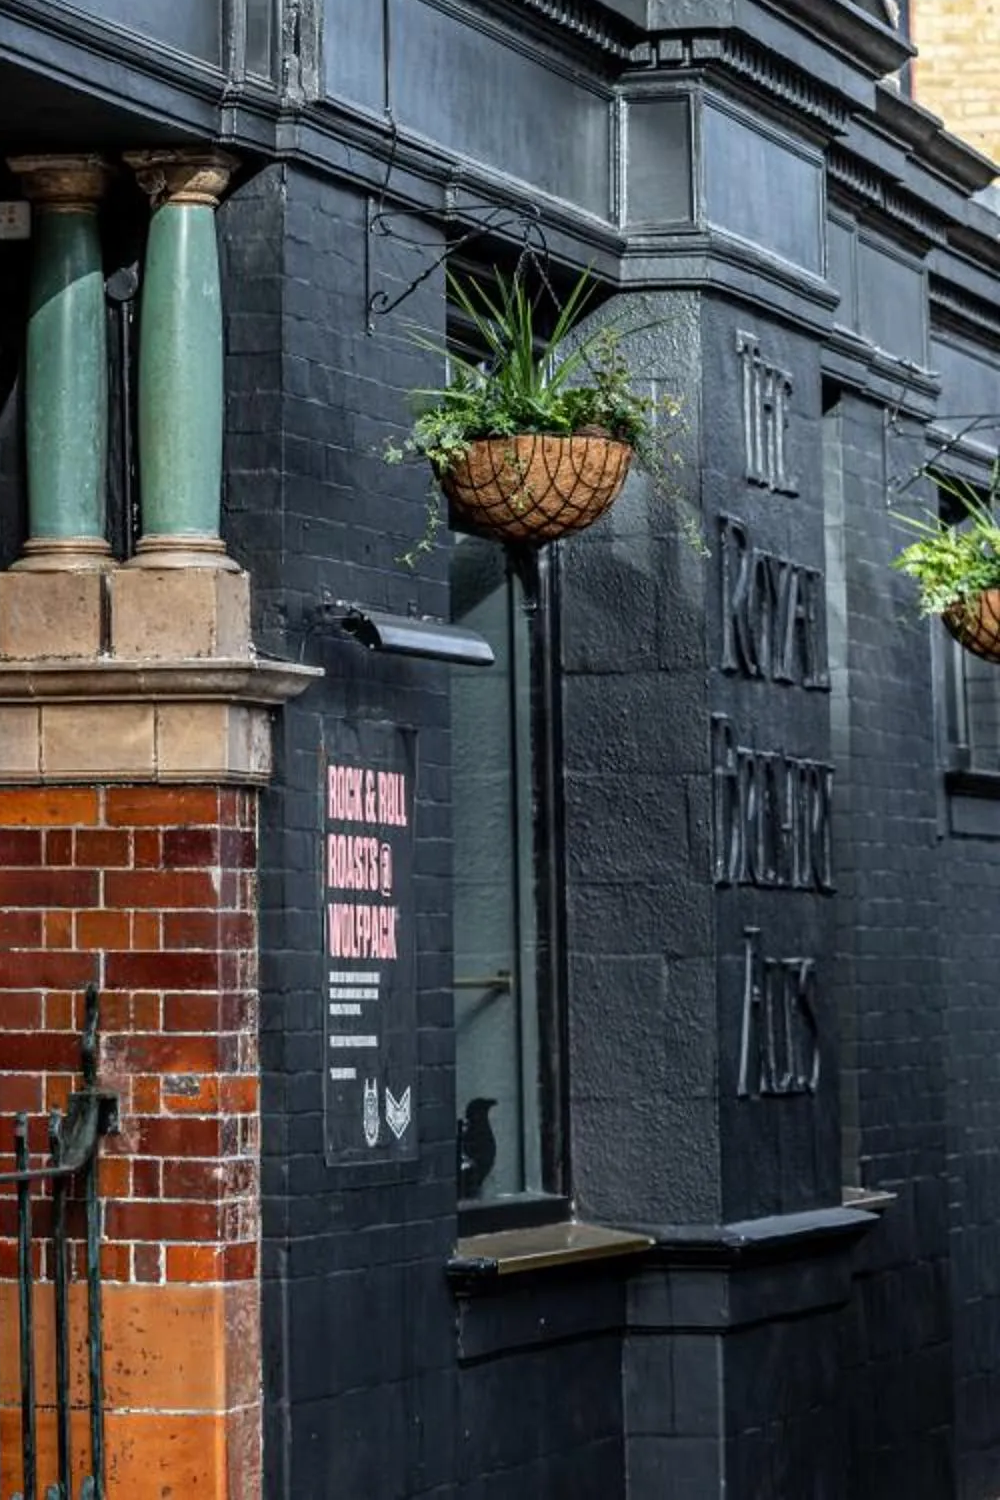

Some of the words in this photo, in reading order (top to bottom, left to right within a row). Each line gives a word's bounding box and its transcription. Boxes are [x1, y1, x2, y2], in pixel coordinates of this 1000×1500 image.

[327, 764, 363, 822] ROCK
[364, 768, 376, 823] &
[377, 771, 407, 827] ROLL
[327, 832, 378, 891] ROASTS
[327, 902, 397, 960] WOLFPACK
